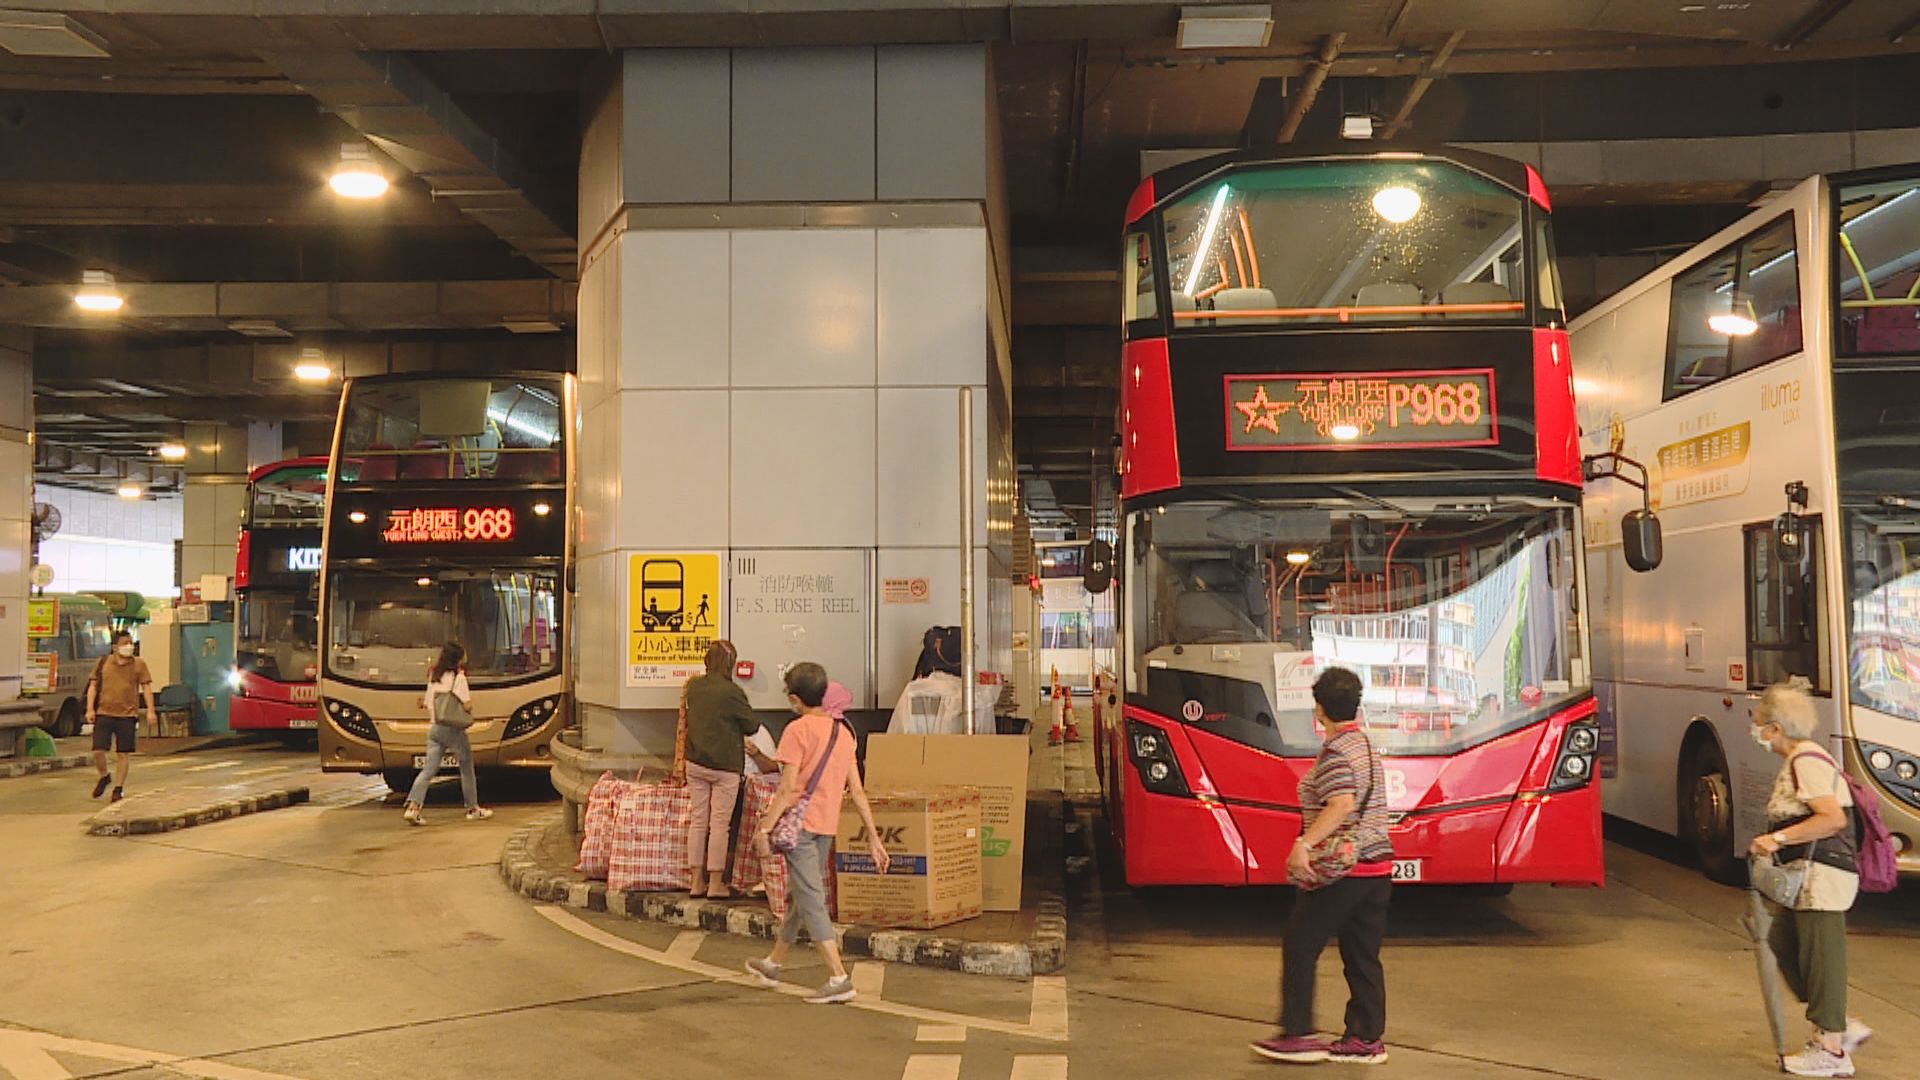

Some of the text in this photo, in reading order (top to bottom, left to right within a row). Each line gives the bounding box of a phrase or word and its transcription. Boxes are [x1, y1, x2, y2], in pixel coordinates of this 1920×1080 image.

[1296, 378, 1388, 407] 元朗西
[1388, 381, 1481, 427] P968
[1761, 379, 1801, 411] illuma
[1345, 402, 1385, 422] LONG
[387, 508, 458, 531] 元朗西
[463, 507, 512, 540] 968
[288, 548, 322, 570] KM
[775, 598, 812, 614] HOSE
[821, 598, 860, 614] REEL
[637, 636, 711, 654] 小心車輛
